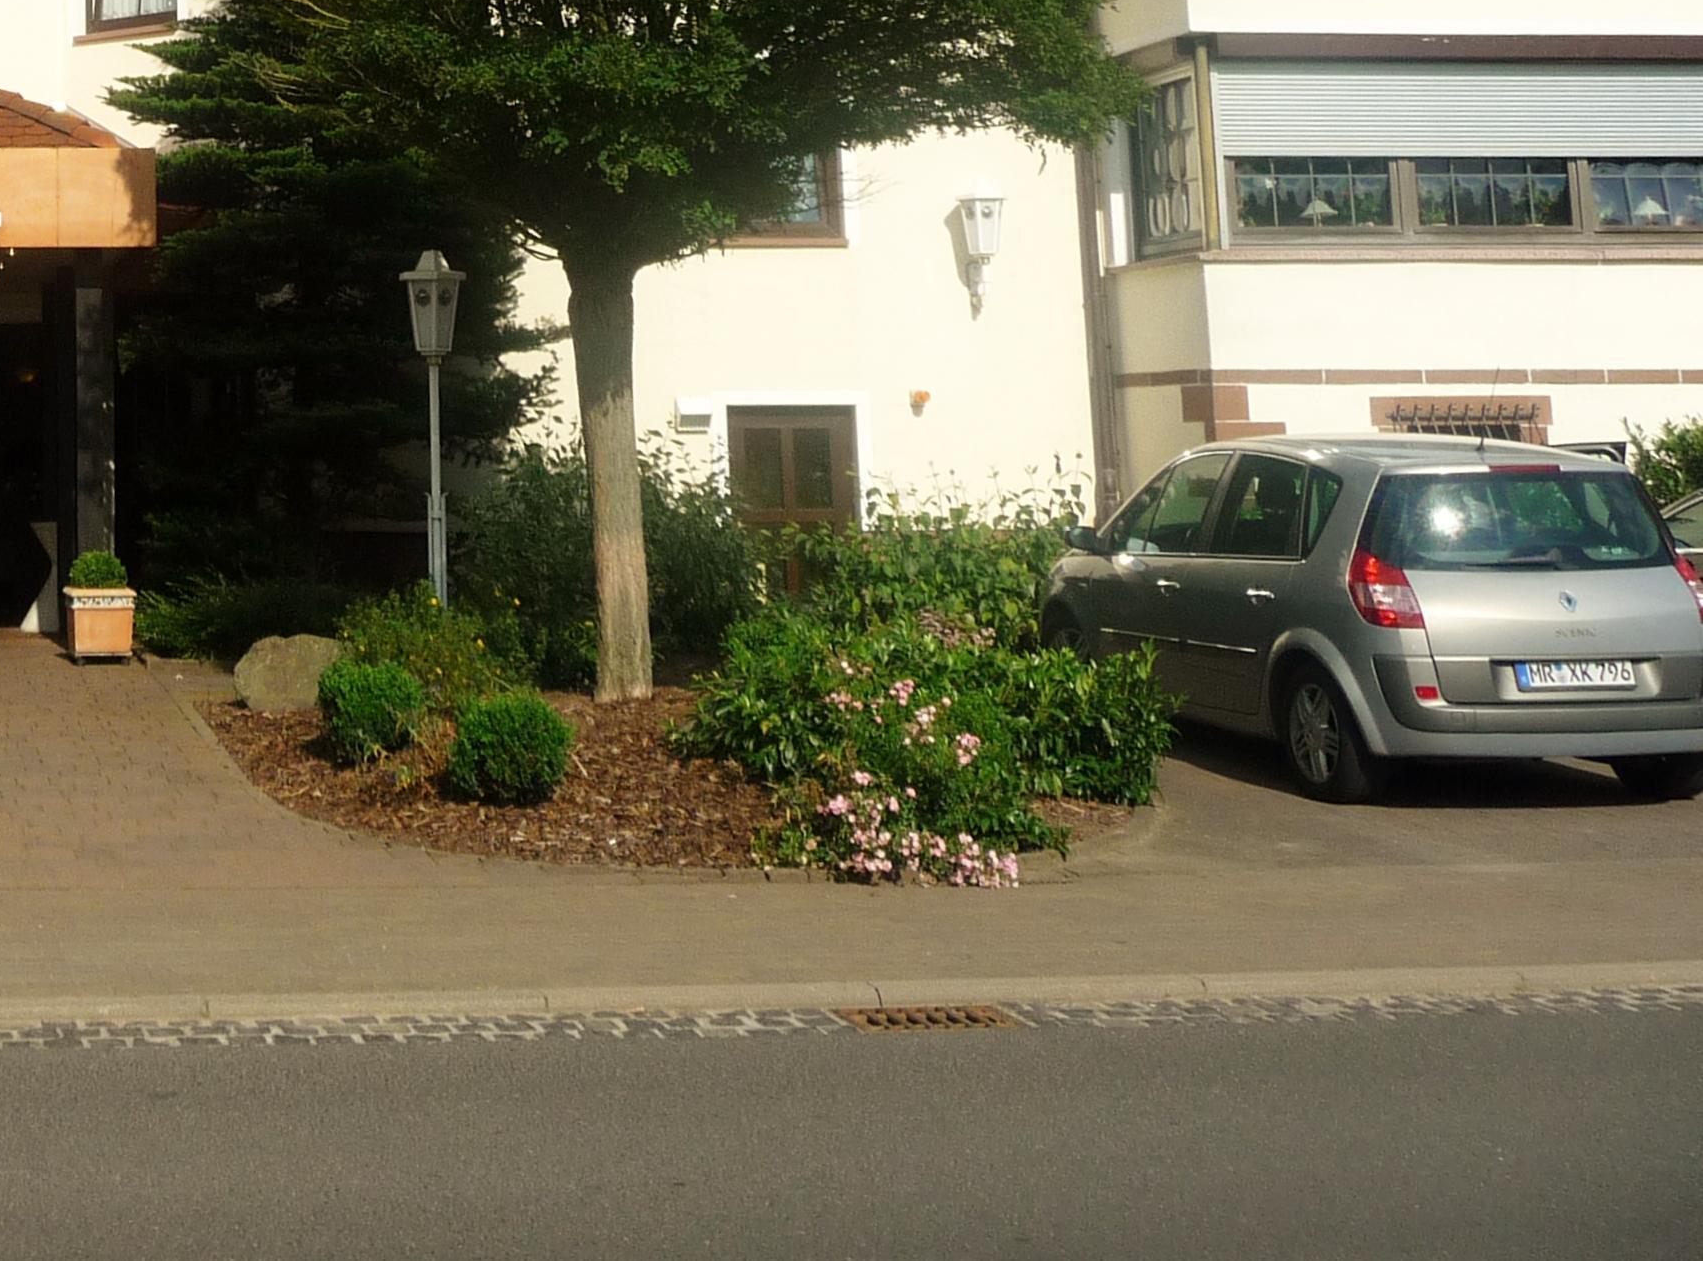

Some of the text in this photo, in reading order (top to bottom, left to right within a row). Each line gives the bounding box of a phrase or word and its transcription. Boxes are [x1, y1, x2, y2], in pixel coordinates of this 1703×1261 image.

[1528, 660, 1631, 683] MR XK 796
